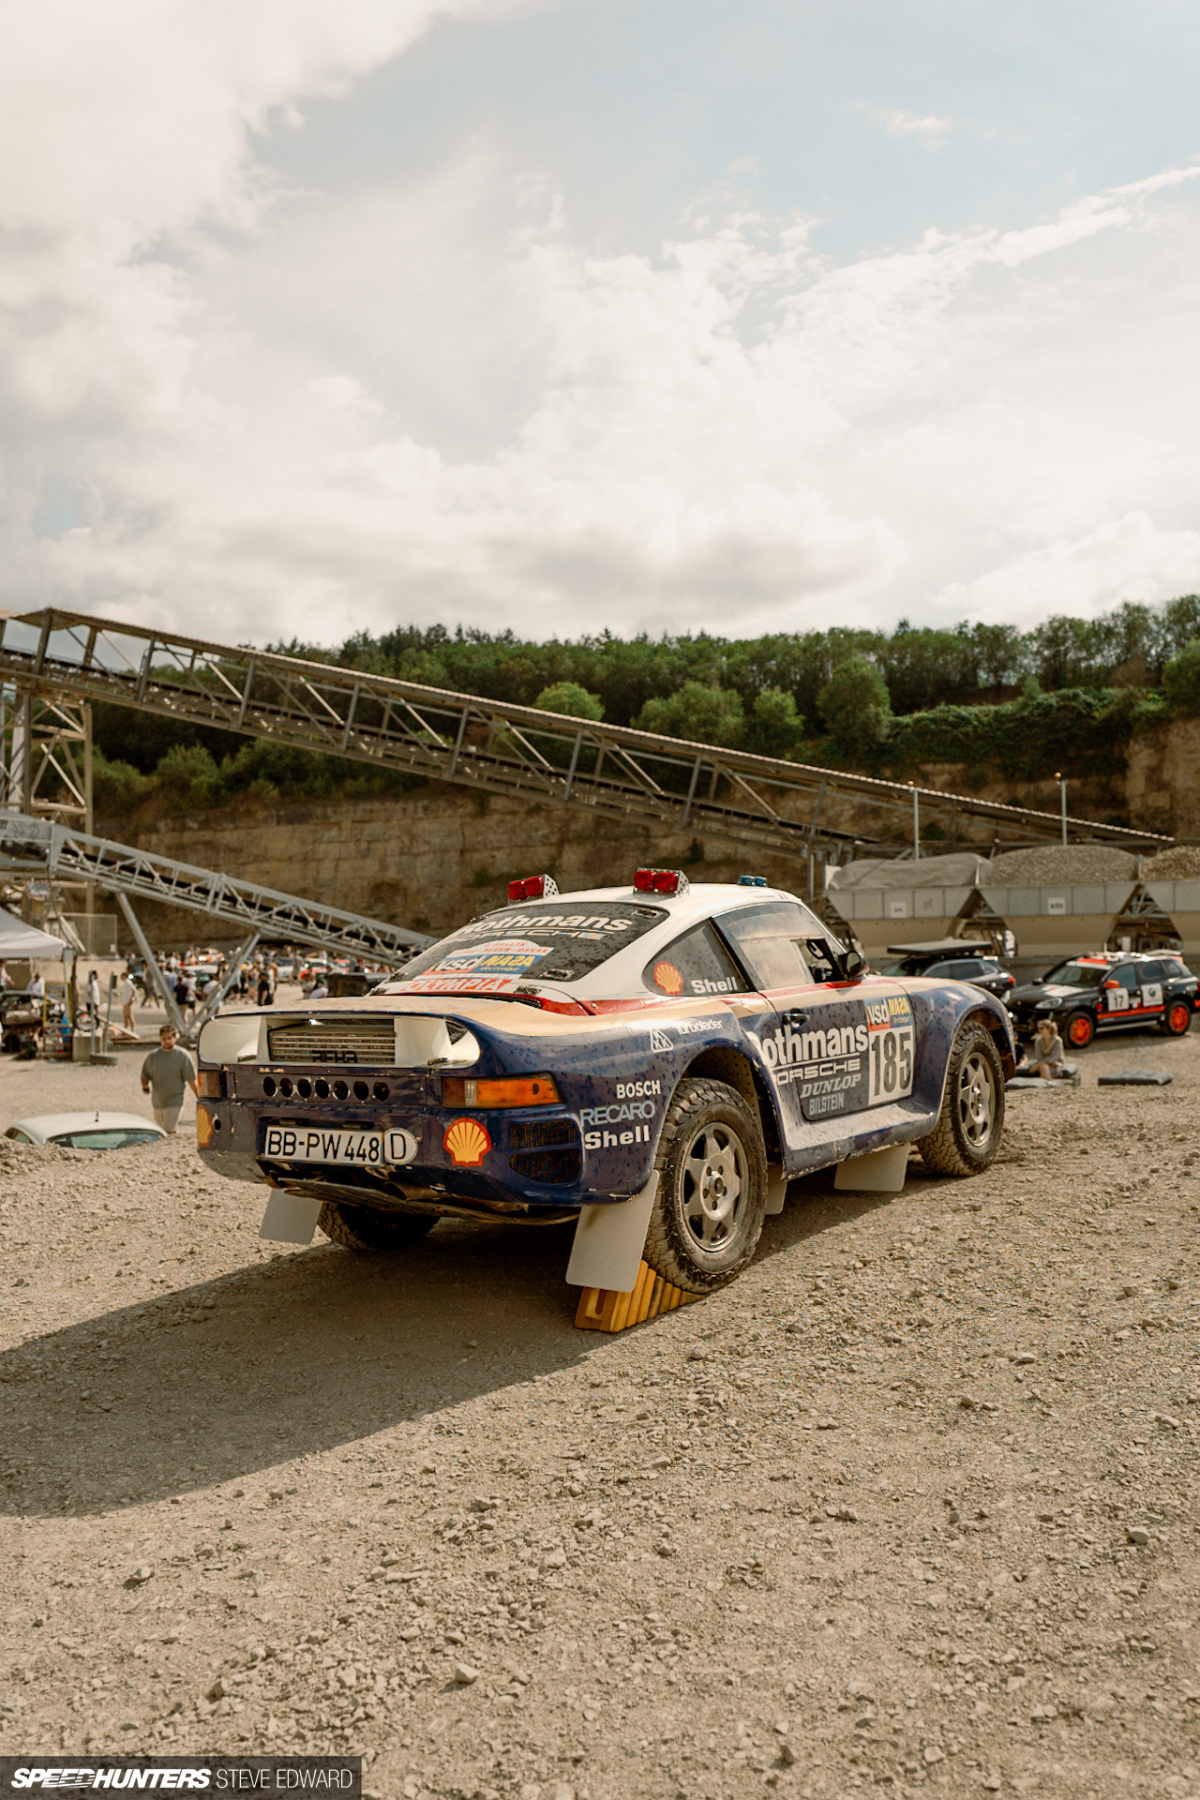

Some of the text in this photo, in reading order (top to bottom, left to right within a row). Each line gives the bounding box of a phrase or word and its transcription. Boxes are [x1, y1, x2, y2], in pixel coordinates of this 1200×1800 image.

[406, 978, 503, 991] OLYMPIA
[691, 976, 738, 994] Shell
[867, 997, 890, 1026] vsd
[774, 1058, 861, 1086] ORSCHE
[871, 1031, 912, 1097] 185
[616, 1080, 661, 1100] BOSCH
[800, 1074, 861, 1099] DUNLOP
[579, 1100, 656, 1127] RECARO
[809, 1092, 845, 1115] BILSTEIN
[344, 1135, 380, 1163] 448
[390, 1132, 406, 1160] D
[584, 1125, 650, 1150] Shell
